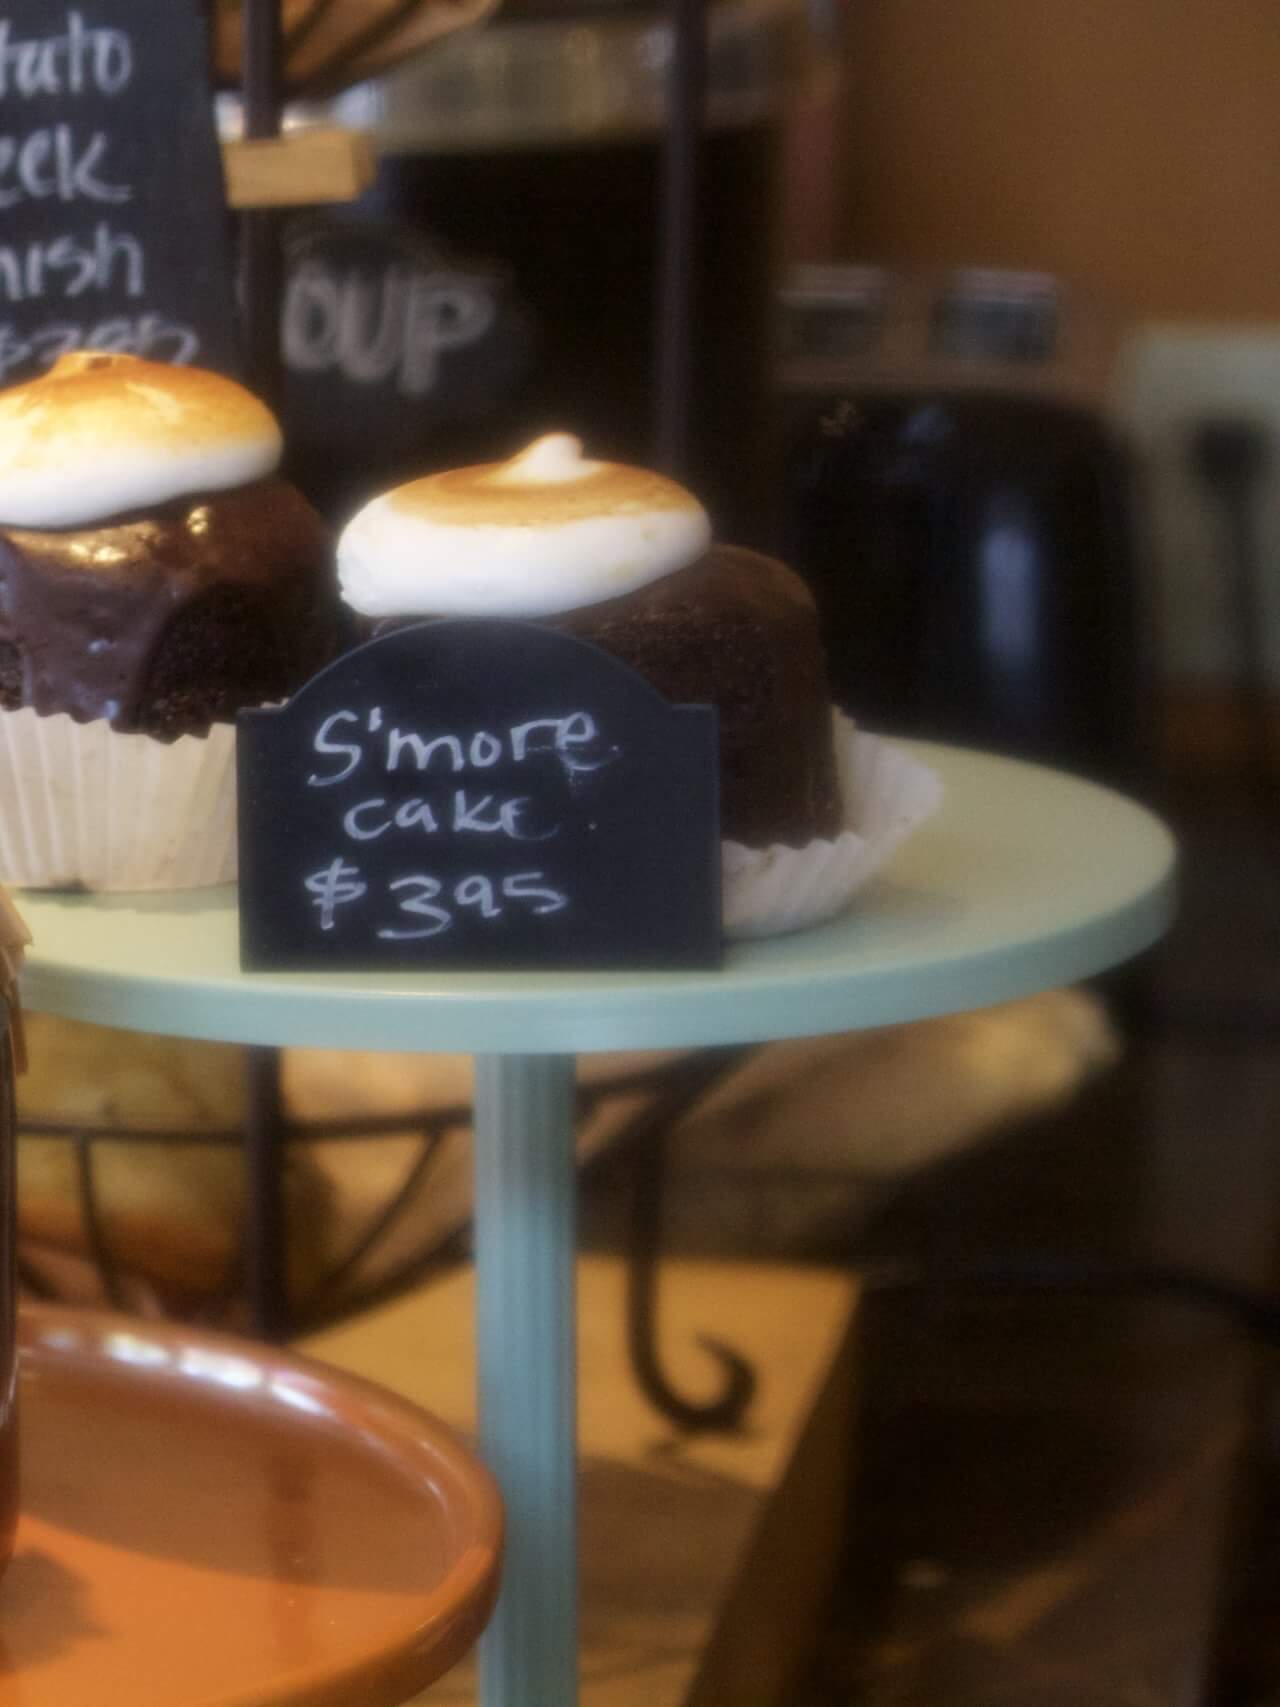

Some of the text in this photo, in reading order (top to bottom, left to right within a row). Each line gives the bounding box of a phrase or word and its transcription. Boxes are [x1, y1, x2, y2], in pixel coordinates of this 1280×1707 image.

[278, 262, 496, 394] OUP
[307, 706, 618, 786] S'more
[343, 789, 560, 840] cake
